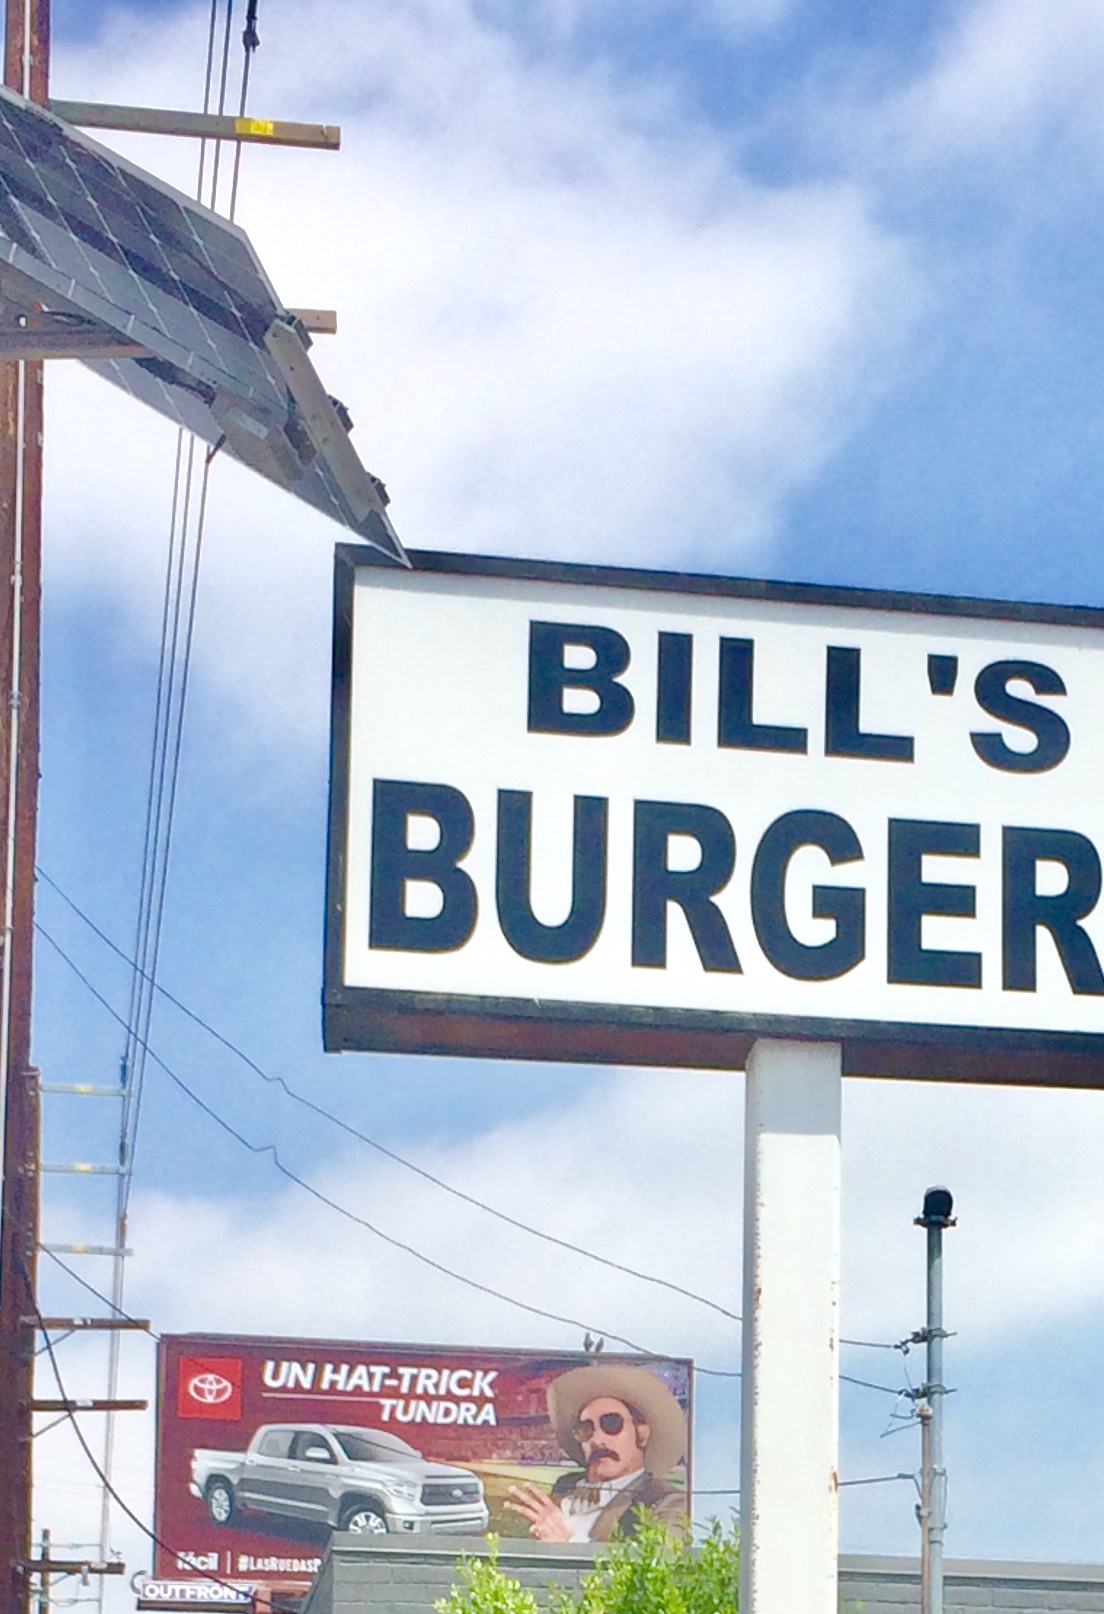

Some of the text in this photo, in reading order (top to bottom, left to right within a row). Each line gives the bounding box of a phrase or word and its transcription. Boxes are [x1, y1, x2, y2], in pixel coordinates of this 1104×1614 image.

[527, 619, 1071, 774] BILL'S
[262, 1359, 498, 1397] UN HAT-TRICK
[379, 1399, 497, 1426] TUNDRA
